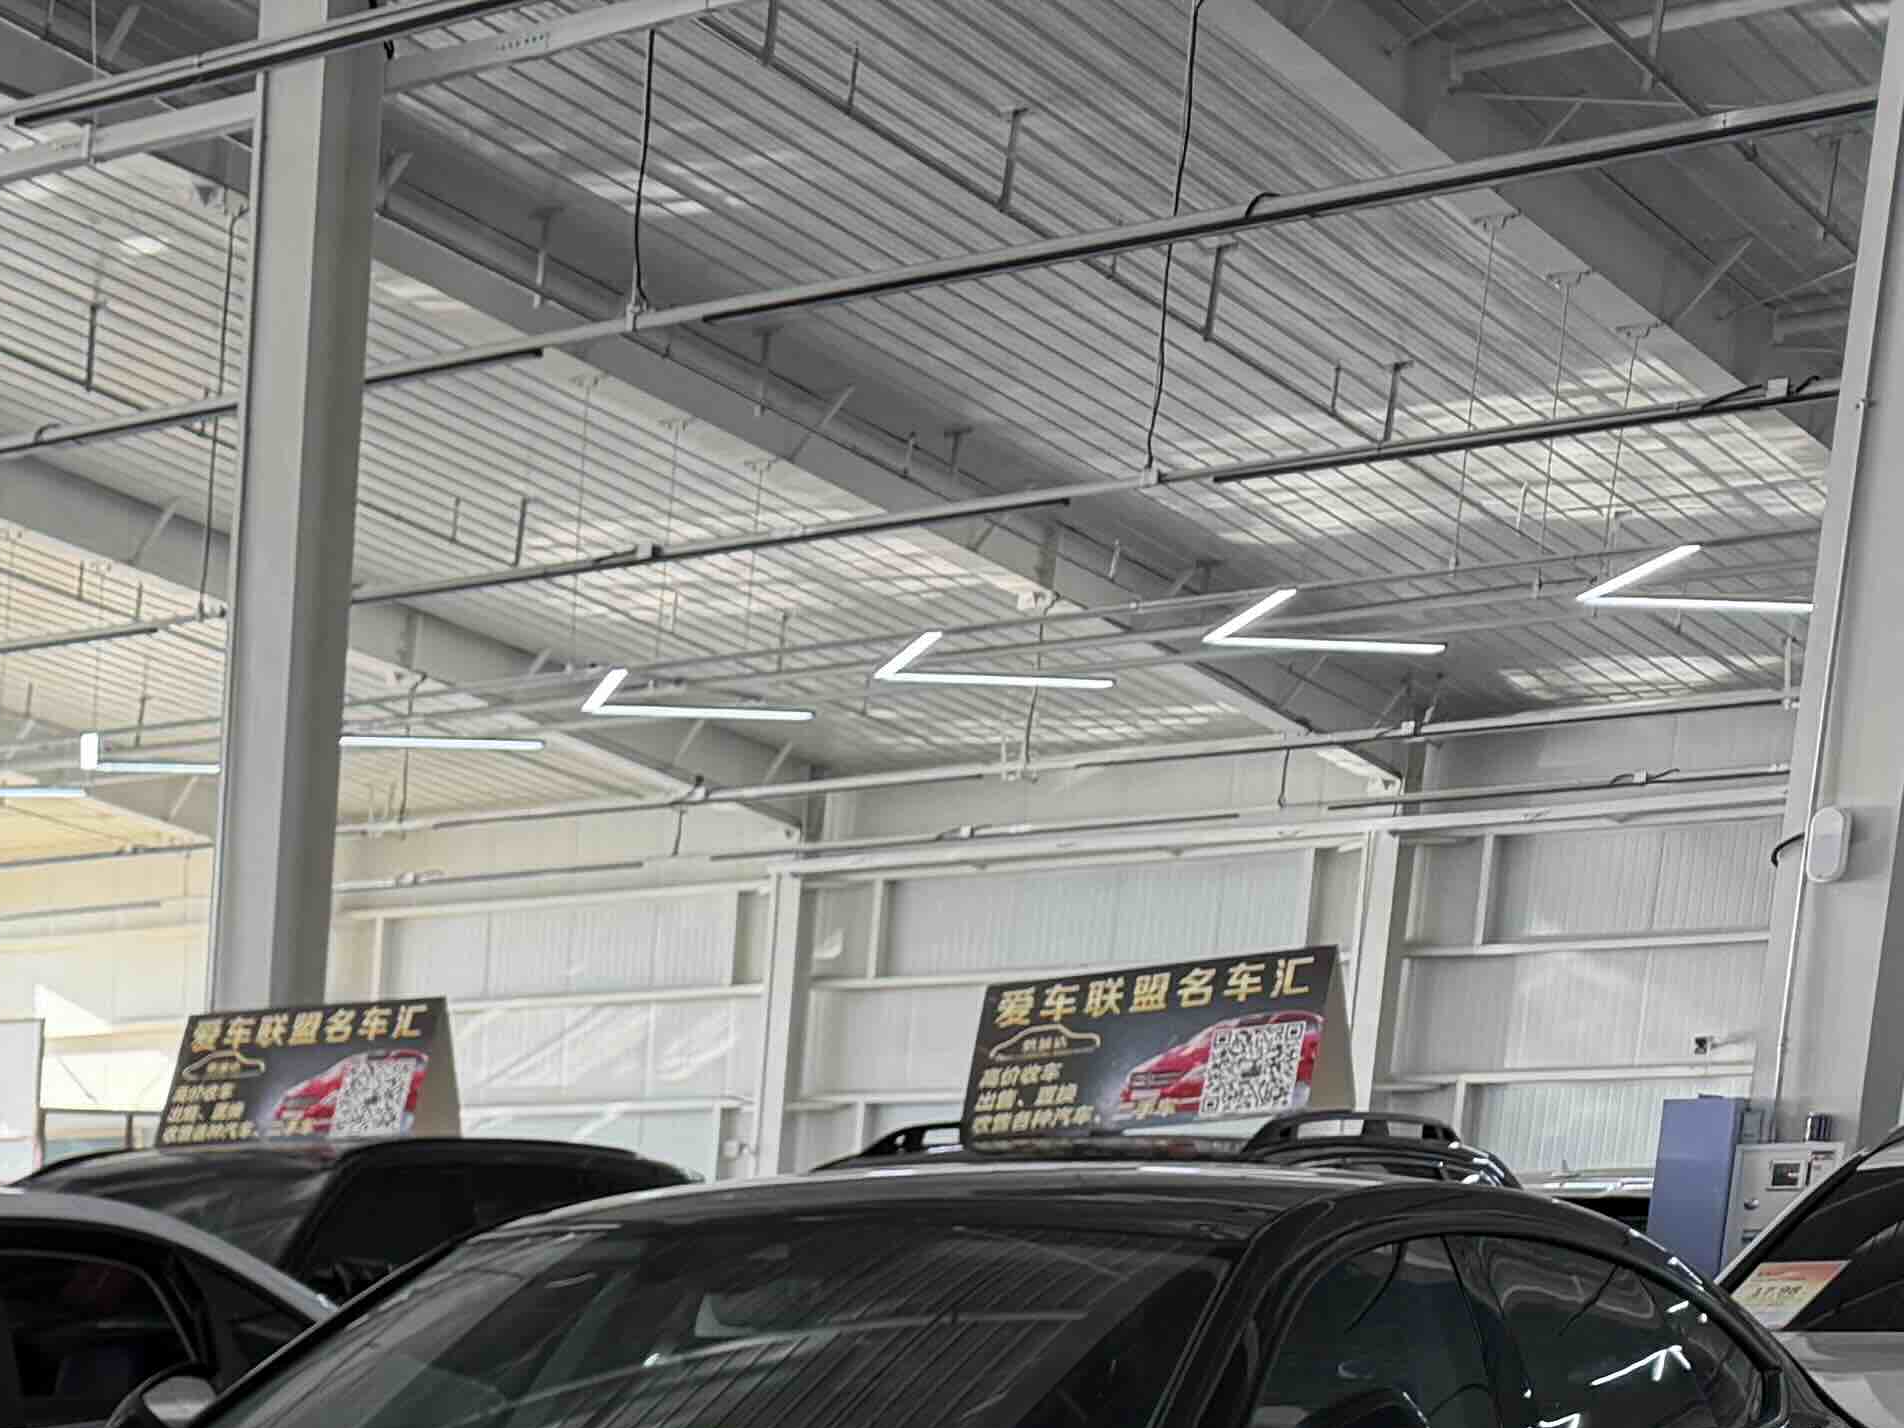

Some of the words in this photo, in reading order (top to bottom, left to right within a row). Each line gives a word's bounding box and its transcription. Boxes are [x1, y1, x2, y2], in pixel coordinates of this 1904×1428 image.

[994, 956, 1316, 1030] 爱车联盟名车汇
[189, 1003, 429, 1053] 爱车联盟名车汇
